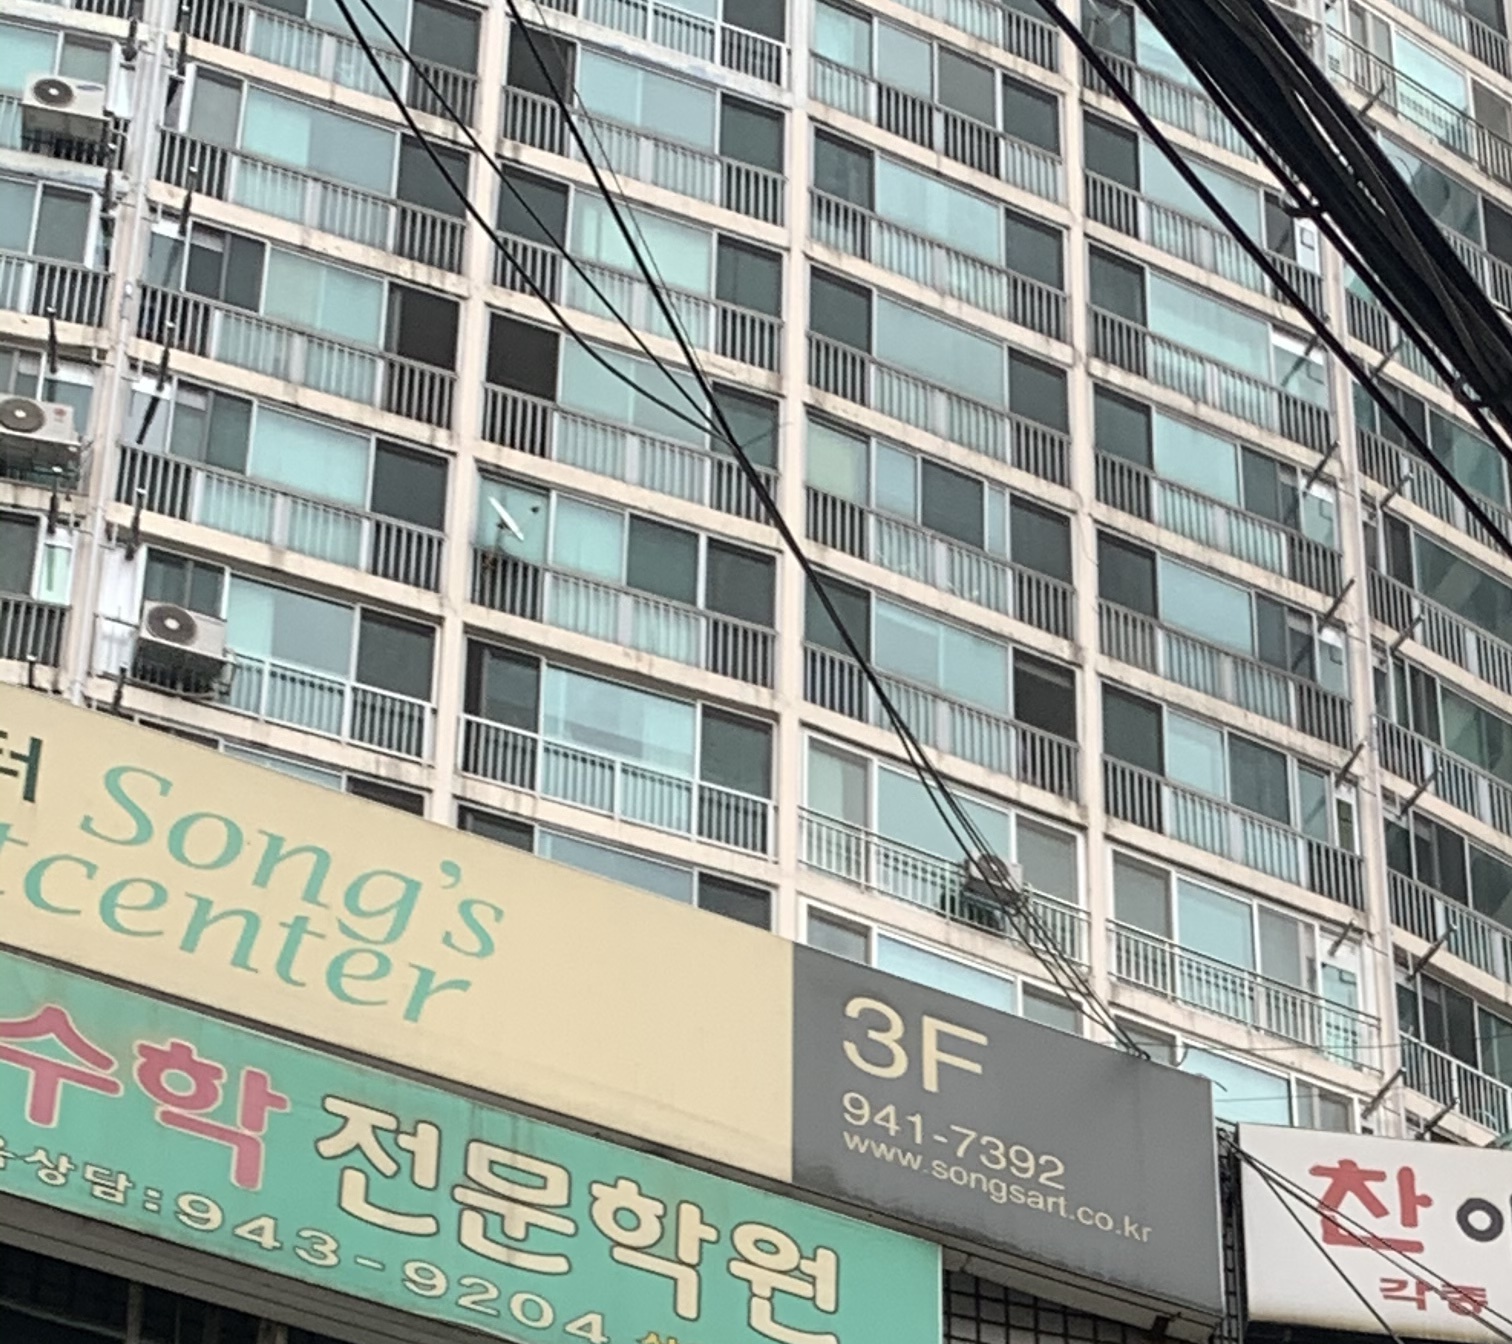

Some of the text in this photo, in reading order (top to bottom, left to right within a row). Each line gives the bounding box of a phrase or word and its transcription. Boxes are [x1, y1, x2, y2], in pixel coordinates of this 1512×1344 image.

[80, 764, 505, 960] Song's
[23, 853, 472, 1024] center
[0, 1004, 291, 1190] 수학
[842, 996, 989, 1093] 3F
[842, 1091, 1066, 1191] 941-7392
[842, 1130, 1153, 1243] www.songsart.co.kr
